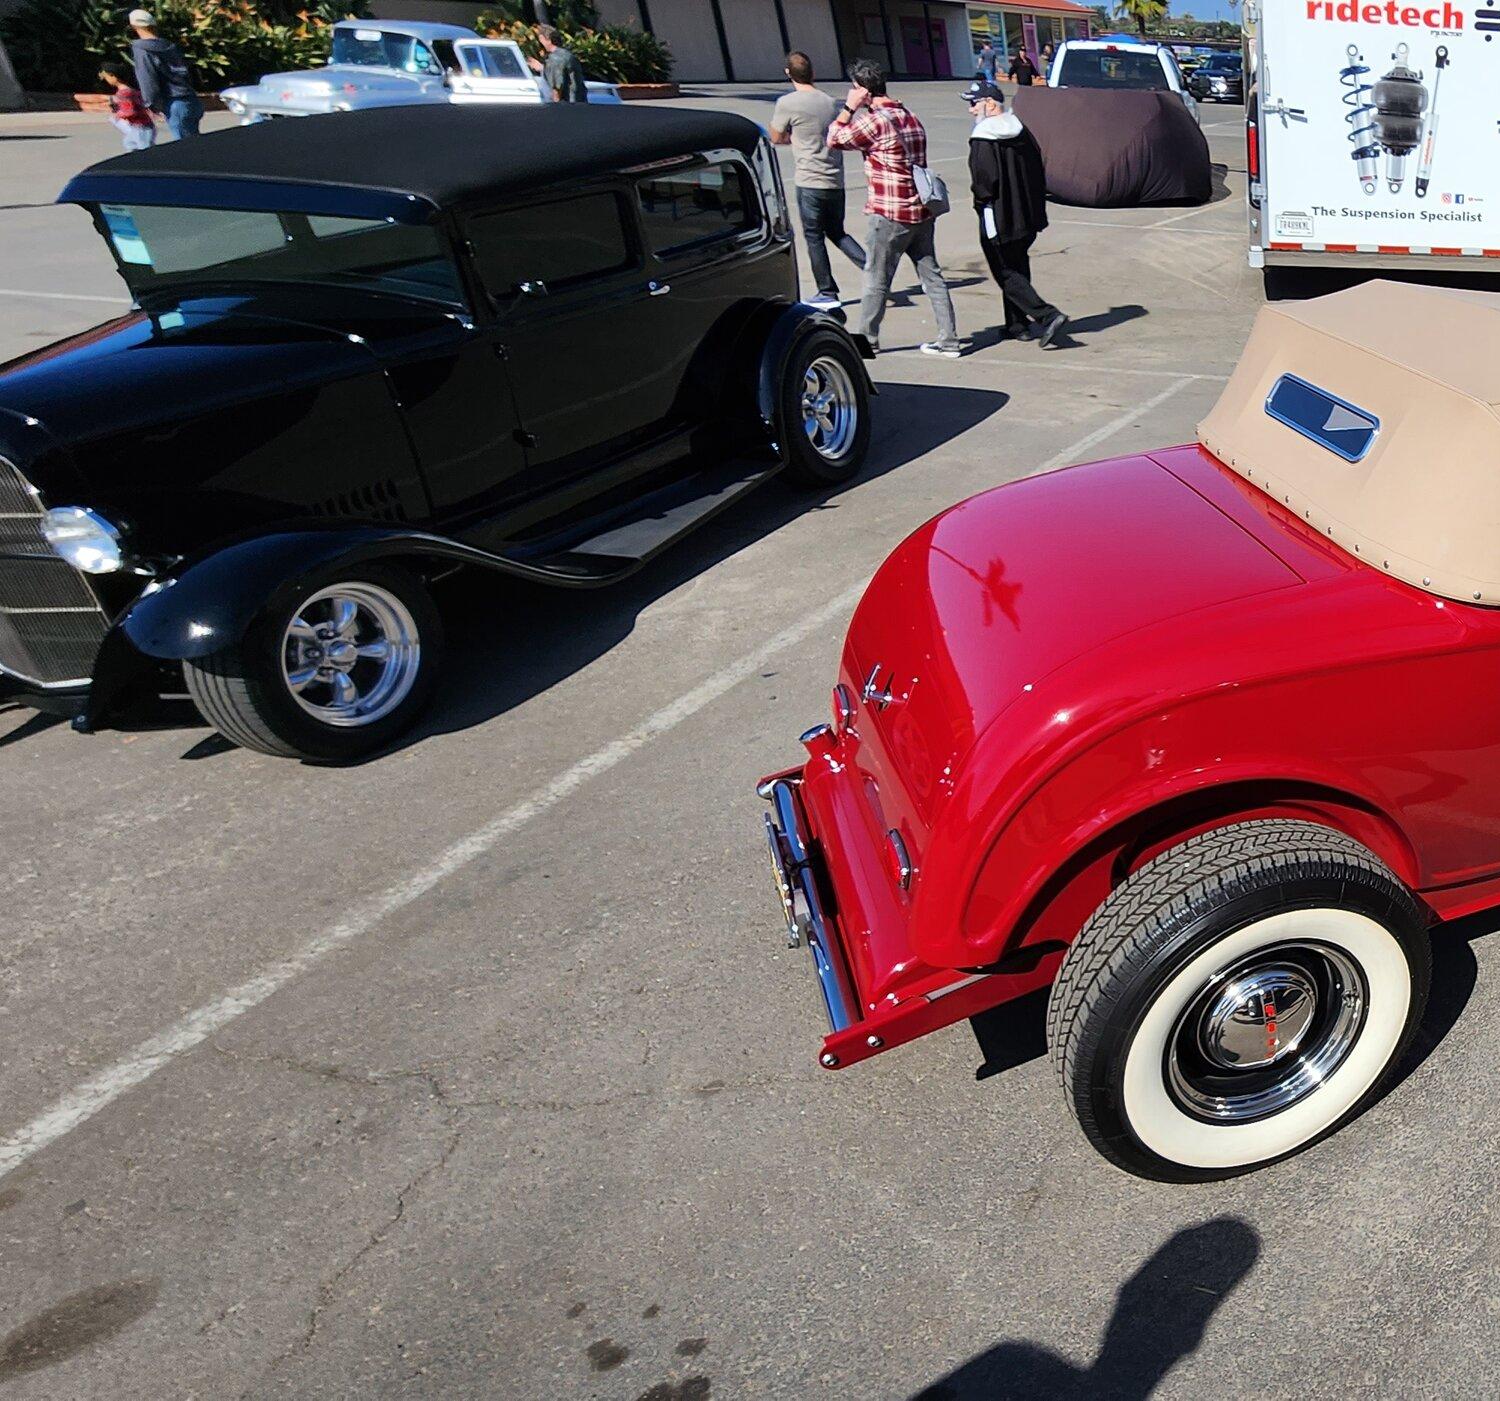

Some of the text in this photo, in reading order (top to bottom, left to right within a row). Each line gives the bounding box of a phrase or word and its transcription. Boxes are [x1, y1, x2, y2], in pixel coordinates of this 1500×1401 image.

[1306, 0, 1464, 30] ridetech
[1311, 206, 1483, 222] The Suspension Specialist
